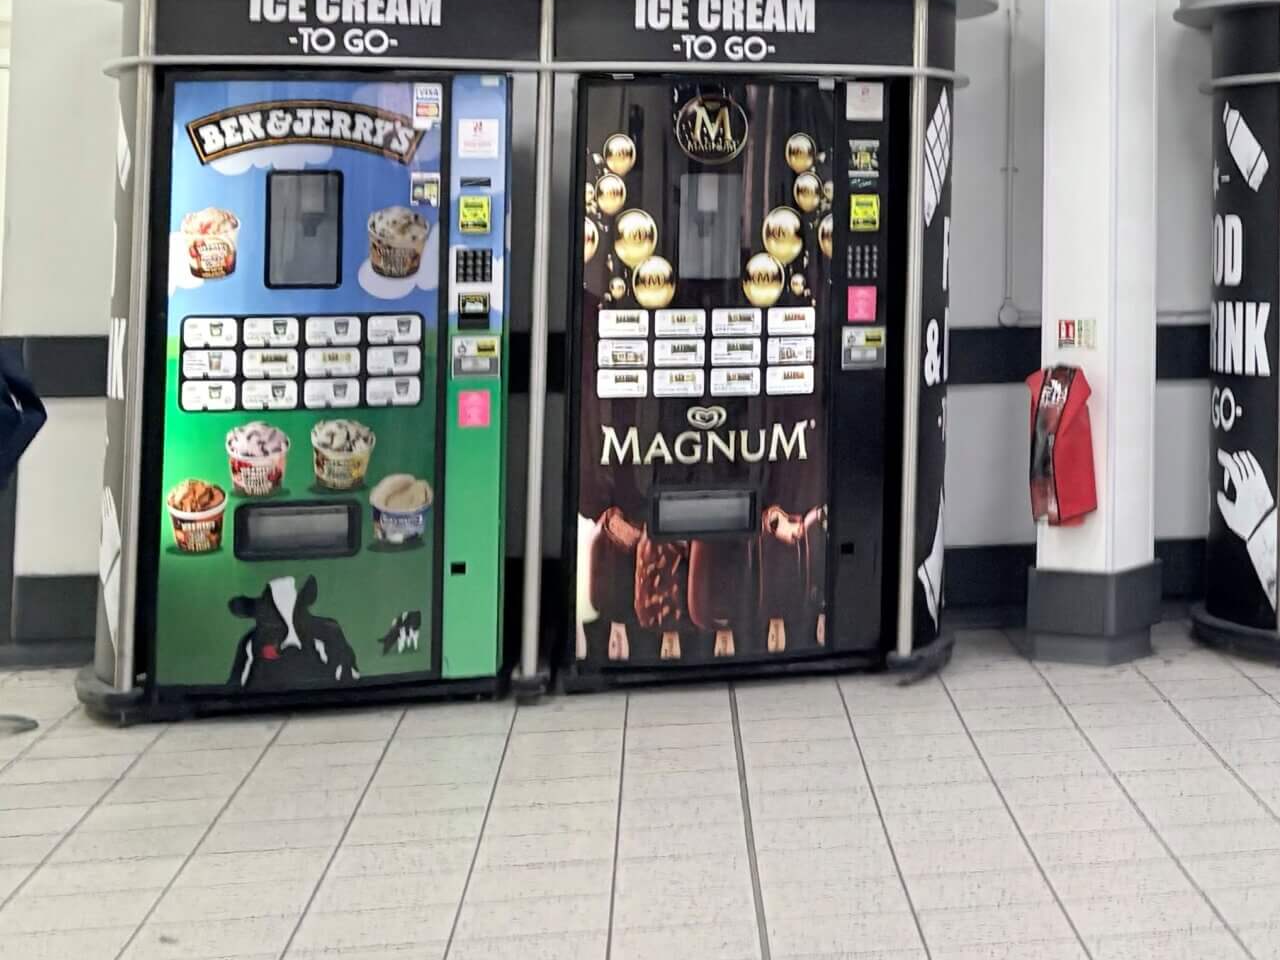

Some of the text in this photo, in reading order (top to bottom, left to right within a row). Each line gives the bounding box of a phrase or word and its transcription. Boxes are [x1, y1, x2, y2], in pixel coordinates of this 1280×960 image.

[199, 111, 266, 155] BEN
[1212, 214, 1243, 287] OD
[1210, 300, 1271, 377] RINK
[600, 419, 809, 466] MAGNUM
